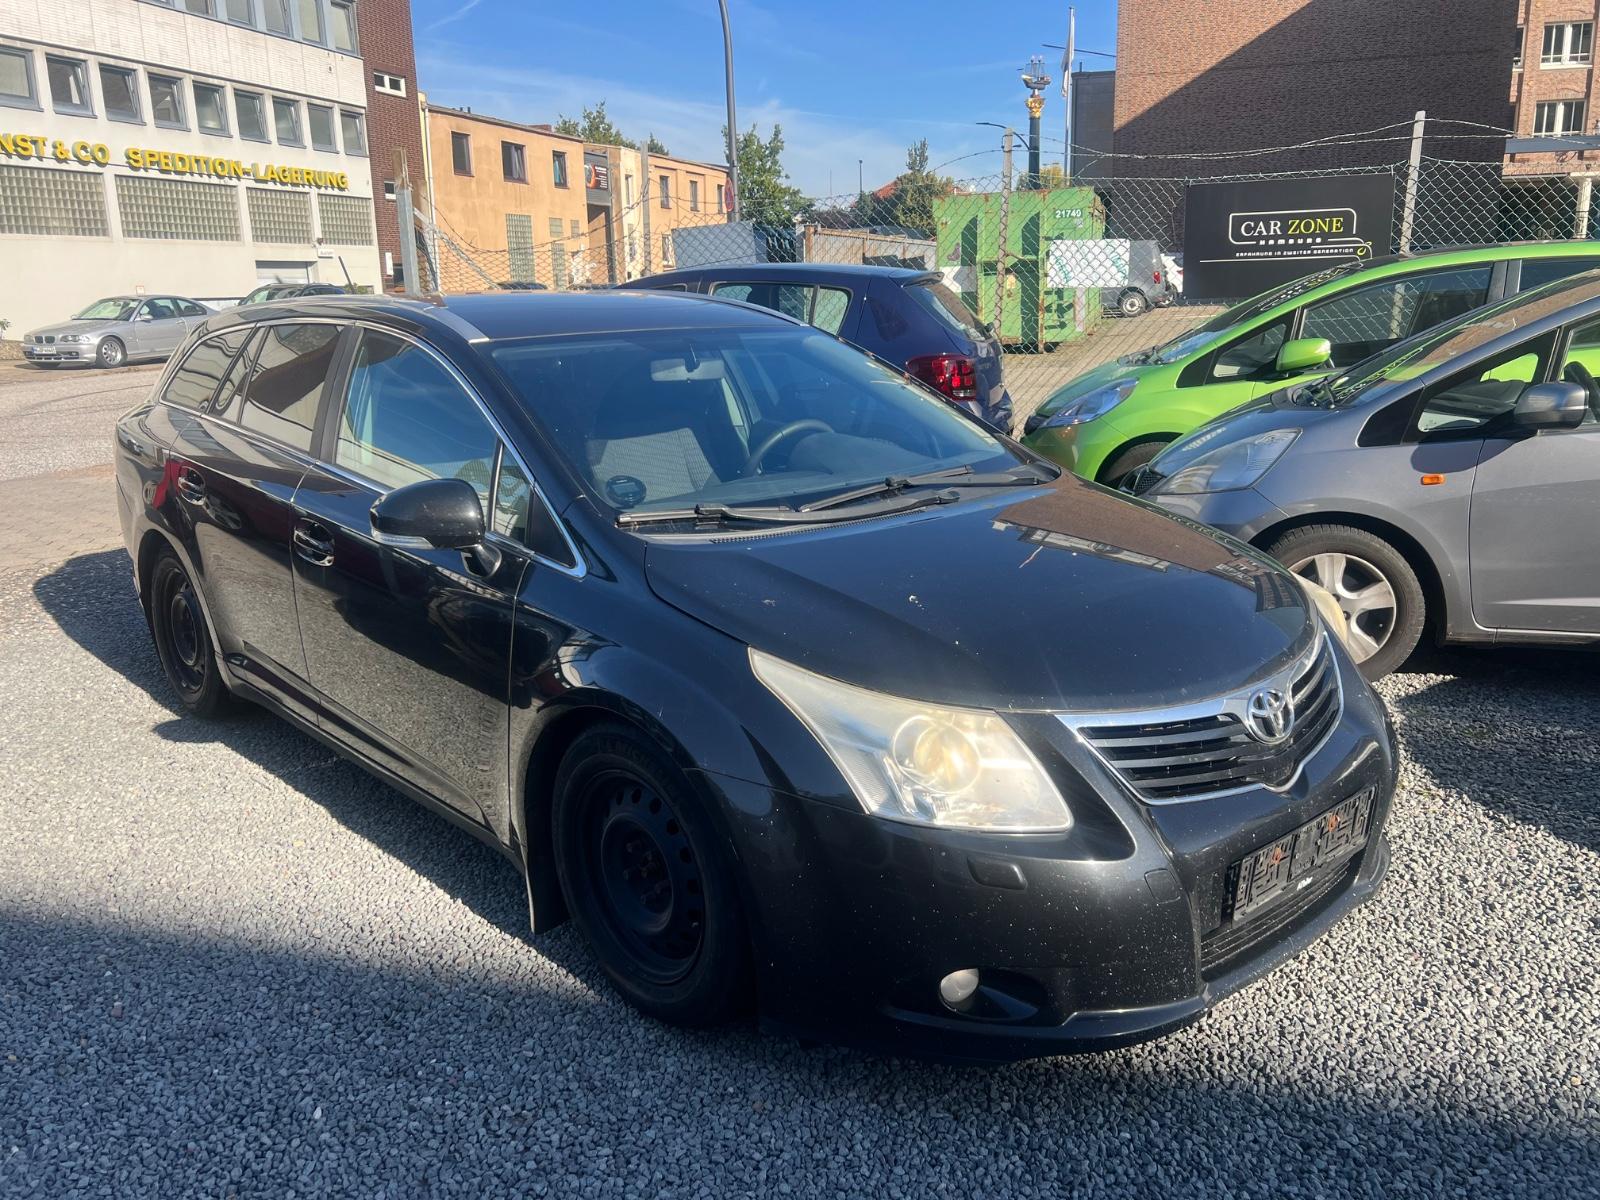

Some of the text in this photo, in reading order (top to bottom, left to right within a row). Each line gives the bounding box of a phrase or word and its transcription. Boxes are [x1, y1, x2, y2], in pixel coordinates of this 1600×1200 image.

[0, 133, 349, 189] NST & CO SPEDITION-LAGERUNG
[1241, 217, 1344, 236] CAR ZONE
